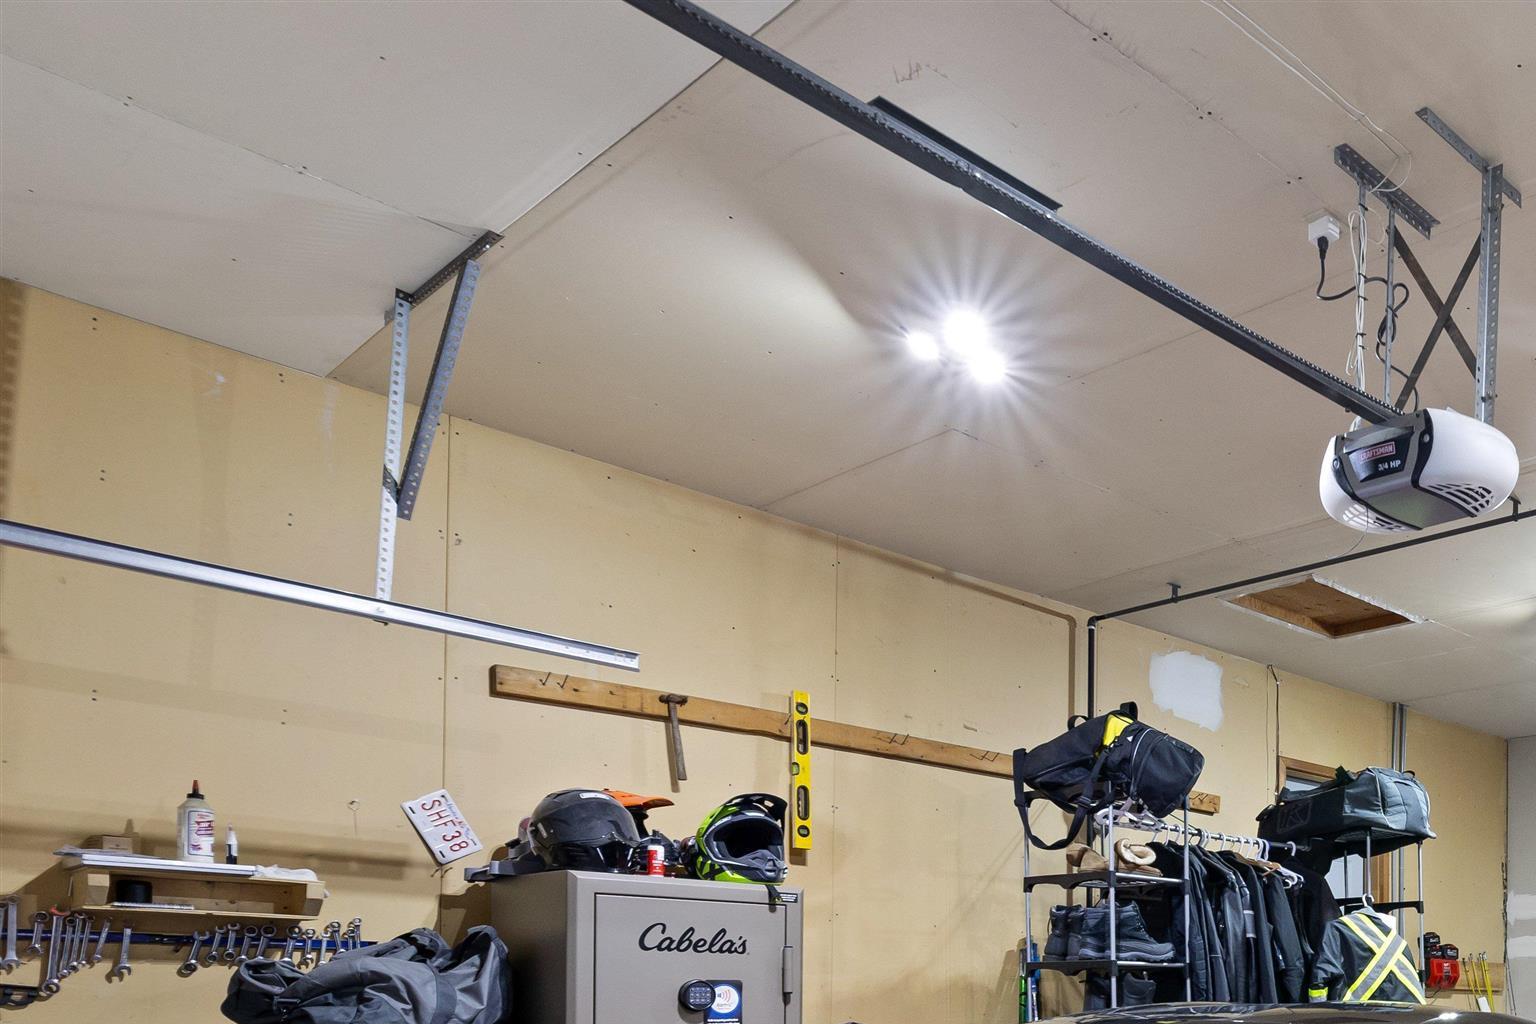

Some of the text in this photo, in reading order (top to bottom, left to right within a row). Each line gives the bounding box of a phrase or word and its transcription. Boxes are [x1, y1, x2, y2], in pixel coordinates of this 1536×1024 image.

[1360, 443, 1394, 461] CRAFTSMAN
[1378, 460, 1401, 471] 3/4 HP
[421, 799, 456, 828] SHF
[442, 830, 469, 852] 38
[638, 922, 748, 955] Cabela's
